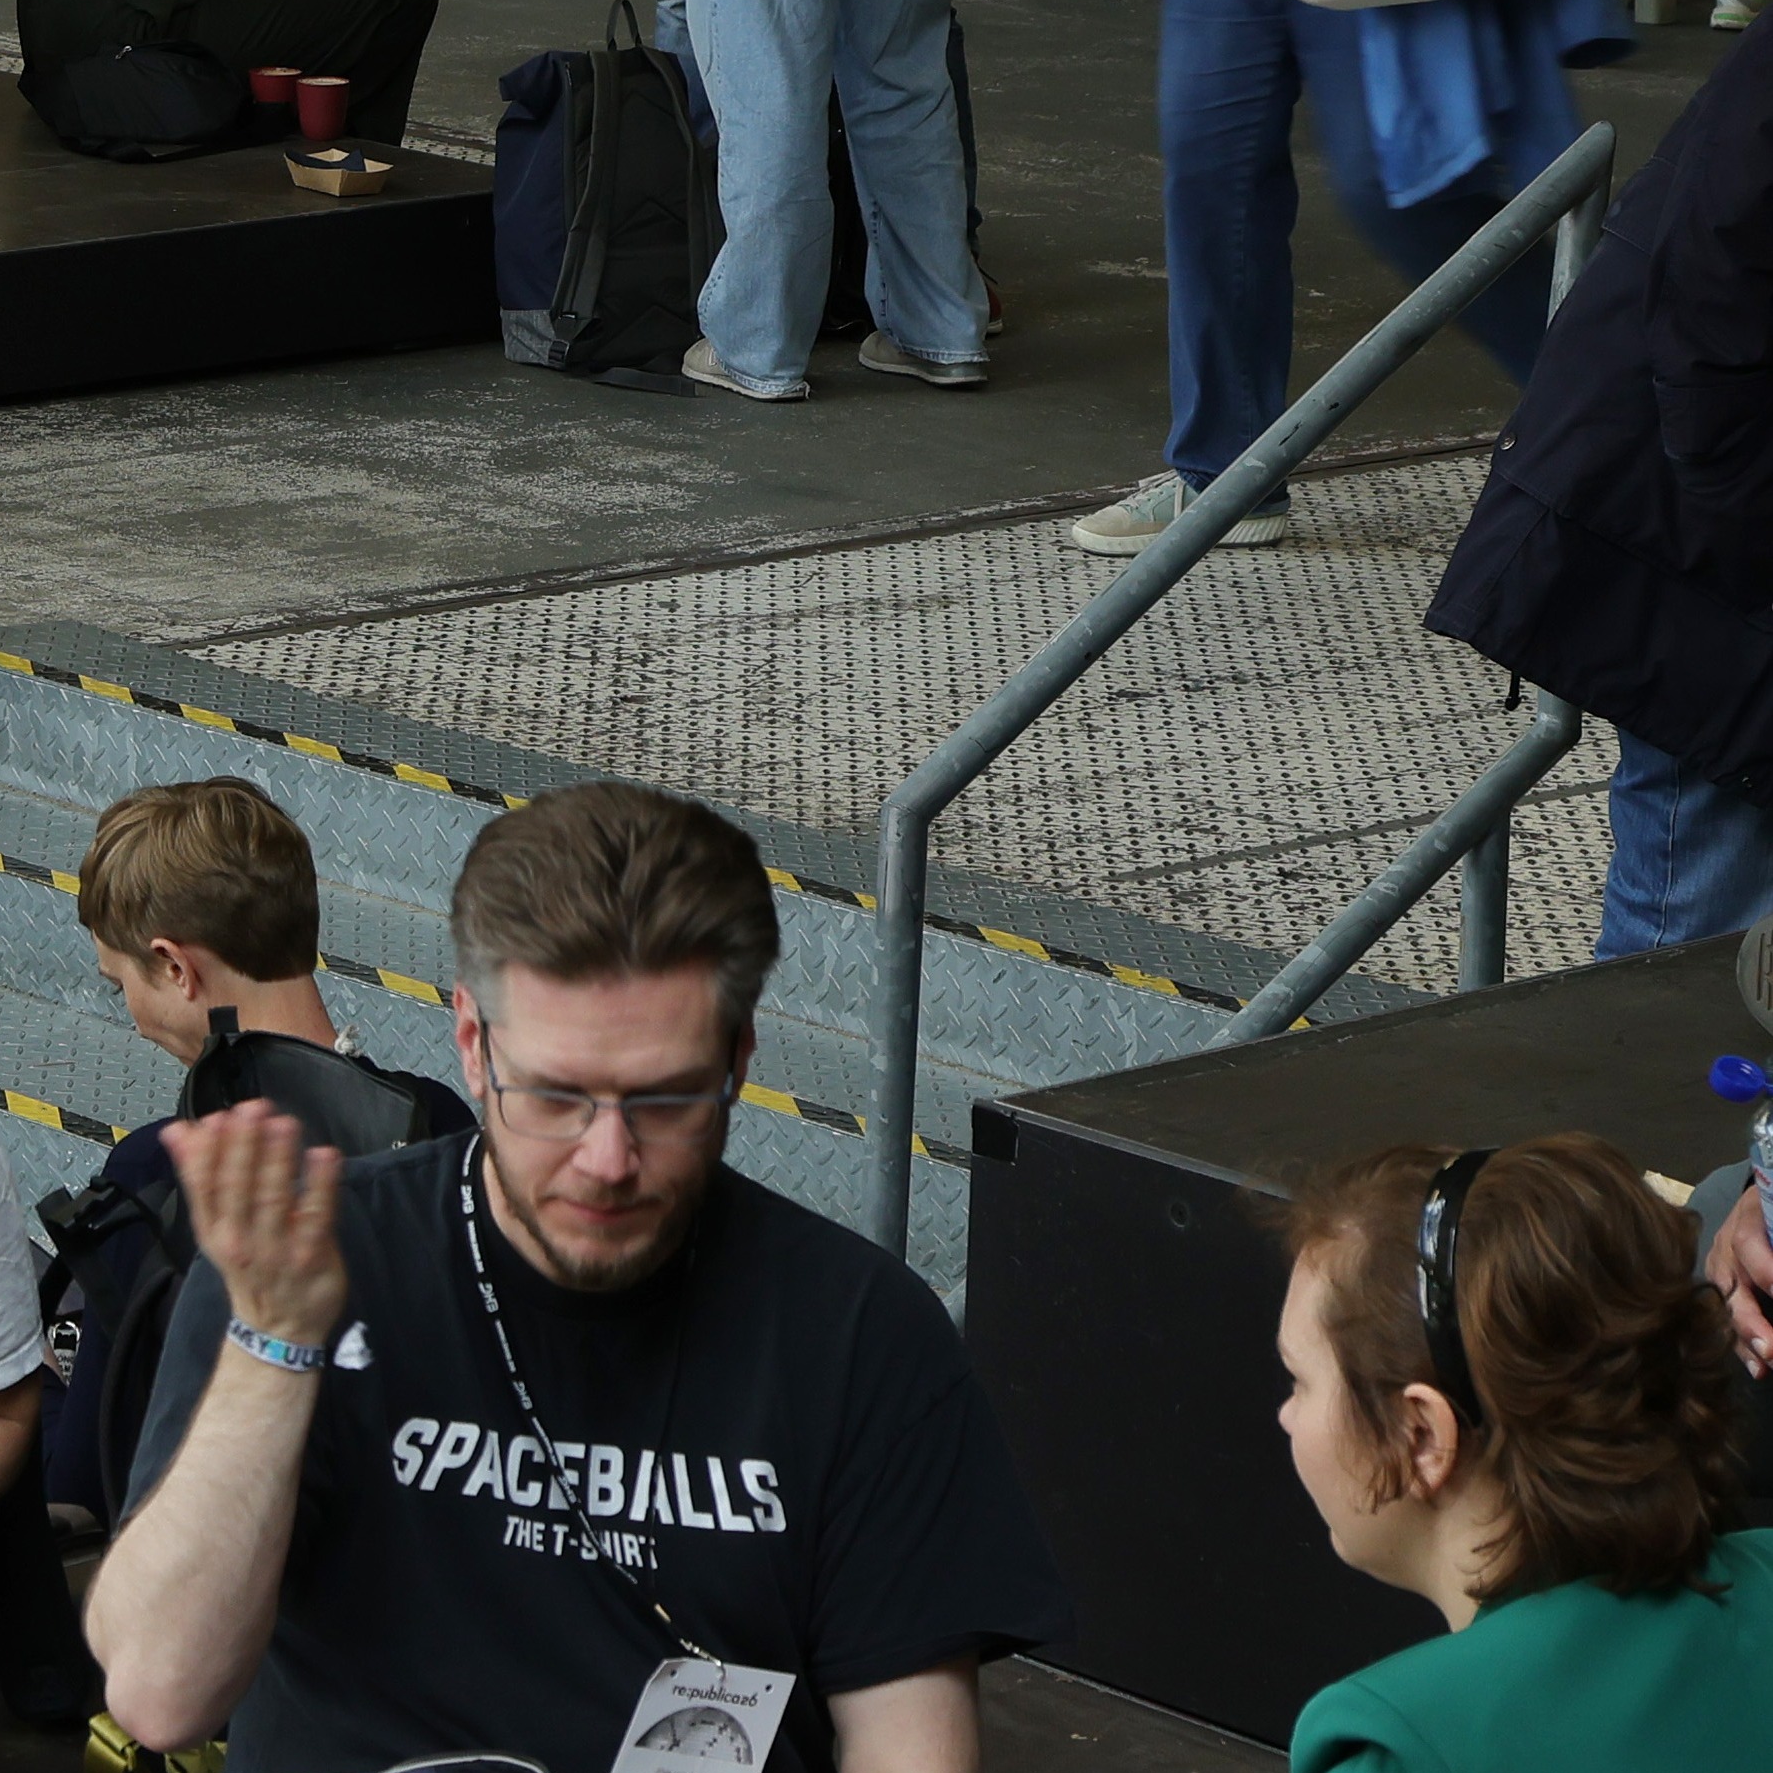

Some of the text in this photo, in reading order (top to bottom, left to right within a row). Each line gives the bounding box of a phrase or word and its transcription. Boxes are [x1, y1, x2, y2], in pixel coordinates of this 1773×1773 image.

[391, 1416, 787, 1534] SPACEBALLS
[503, 1513, 659, 1571] THE T-SHIRT
